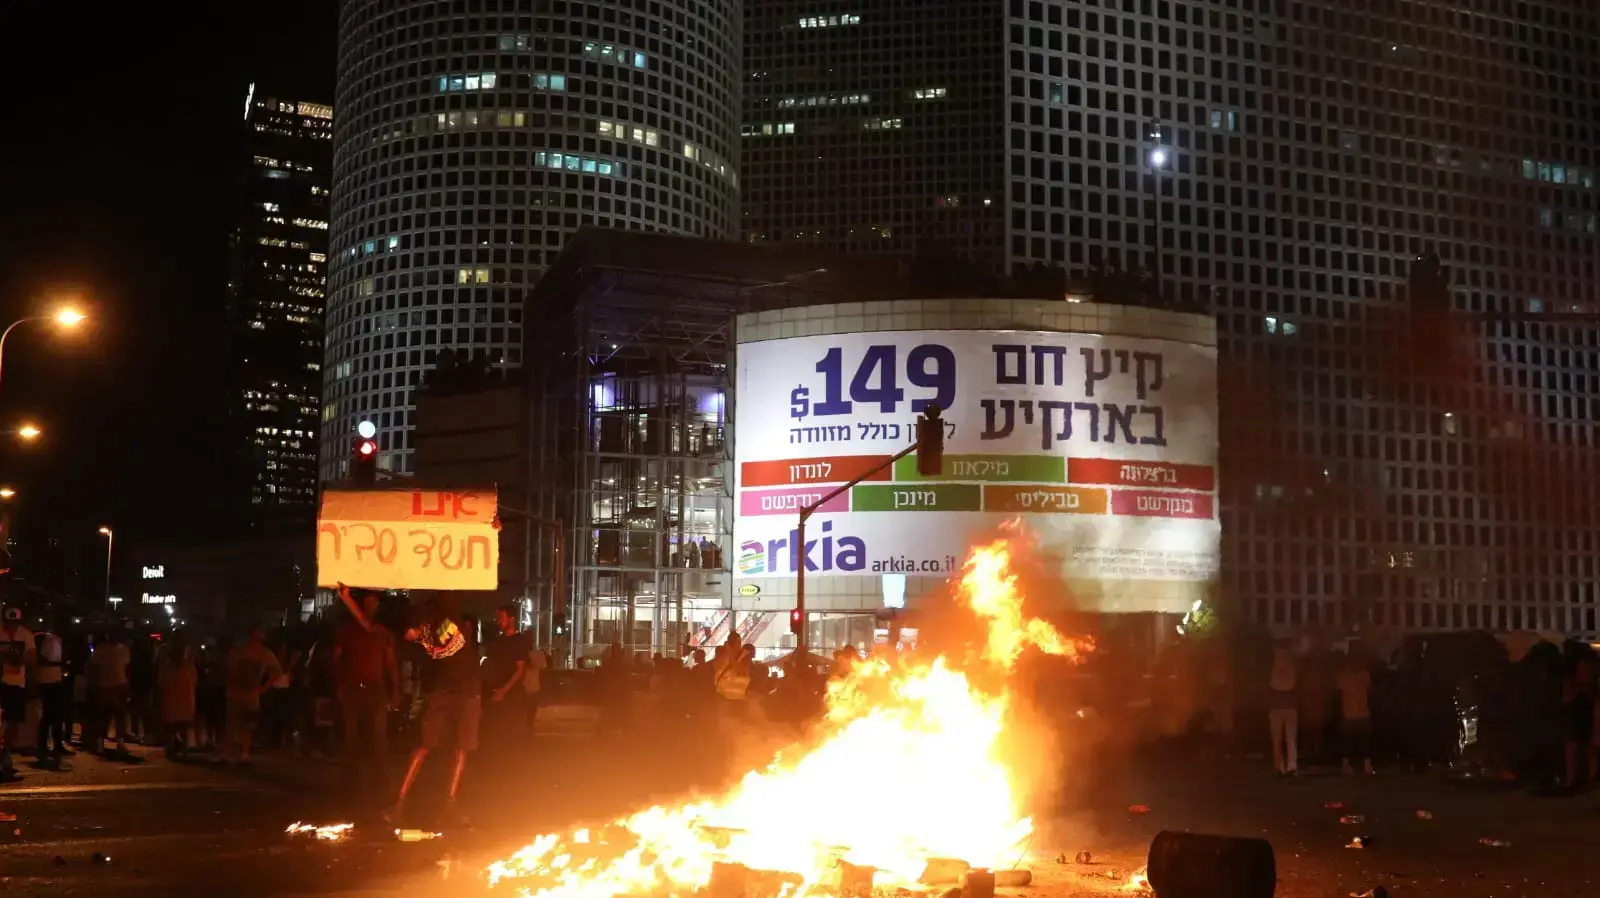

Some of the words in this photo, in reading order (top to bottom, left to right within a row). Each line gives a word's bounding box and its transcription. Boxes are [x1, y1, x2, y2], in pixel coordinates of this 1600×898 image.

[992, 344, 1067, 386] חם
[1080, 347, 1164, 399] קיץ
[790, 424, 851, 444] מזוודה
[857, 422, 900, 440] כולל
[980, 399, 1167, 450] בארקיע
[789, 462, 832, 482] לונדון
[1120, 464, 1177, 483] ברצלונה
[893, 489, 937, 508] מינכן
[1015, 490, 1080, 508] טביליסי
[319, 522, 398, 564] סביר
[738, 520, 867, 575] arkia
